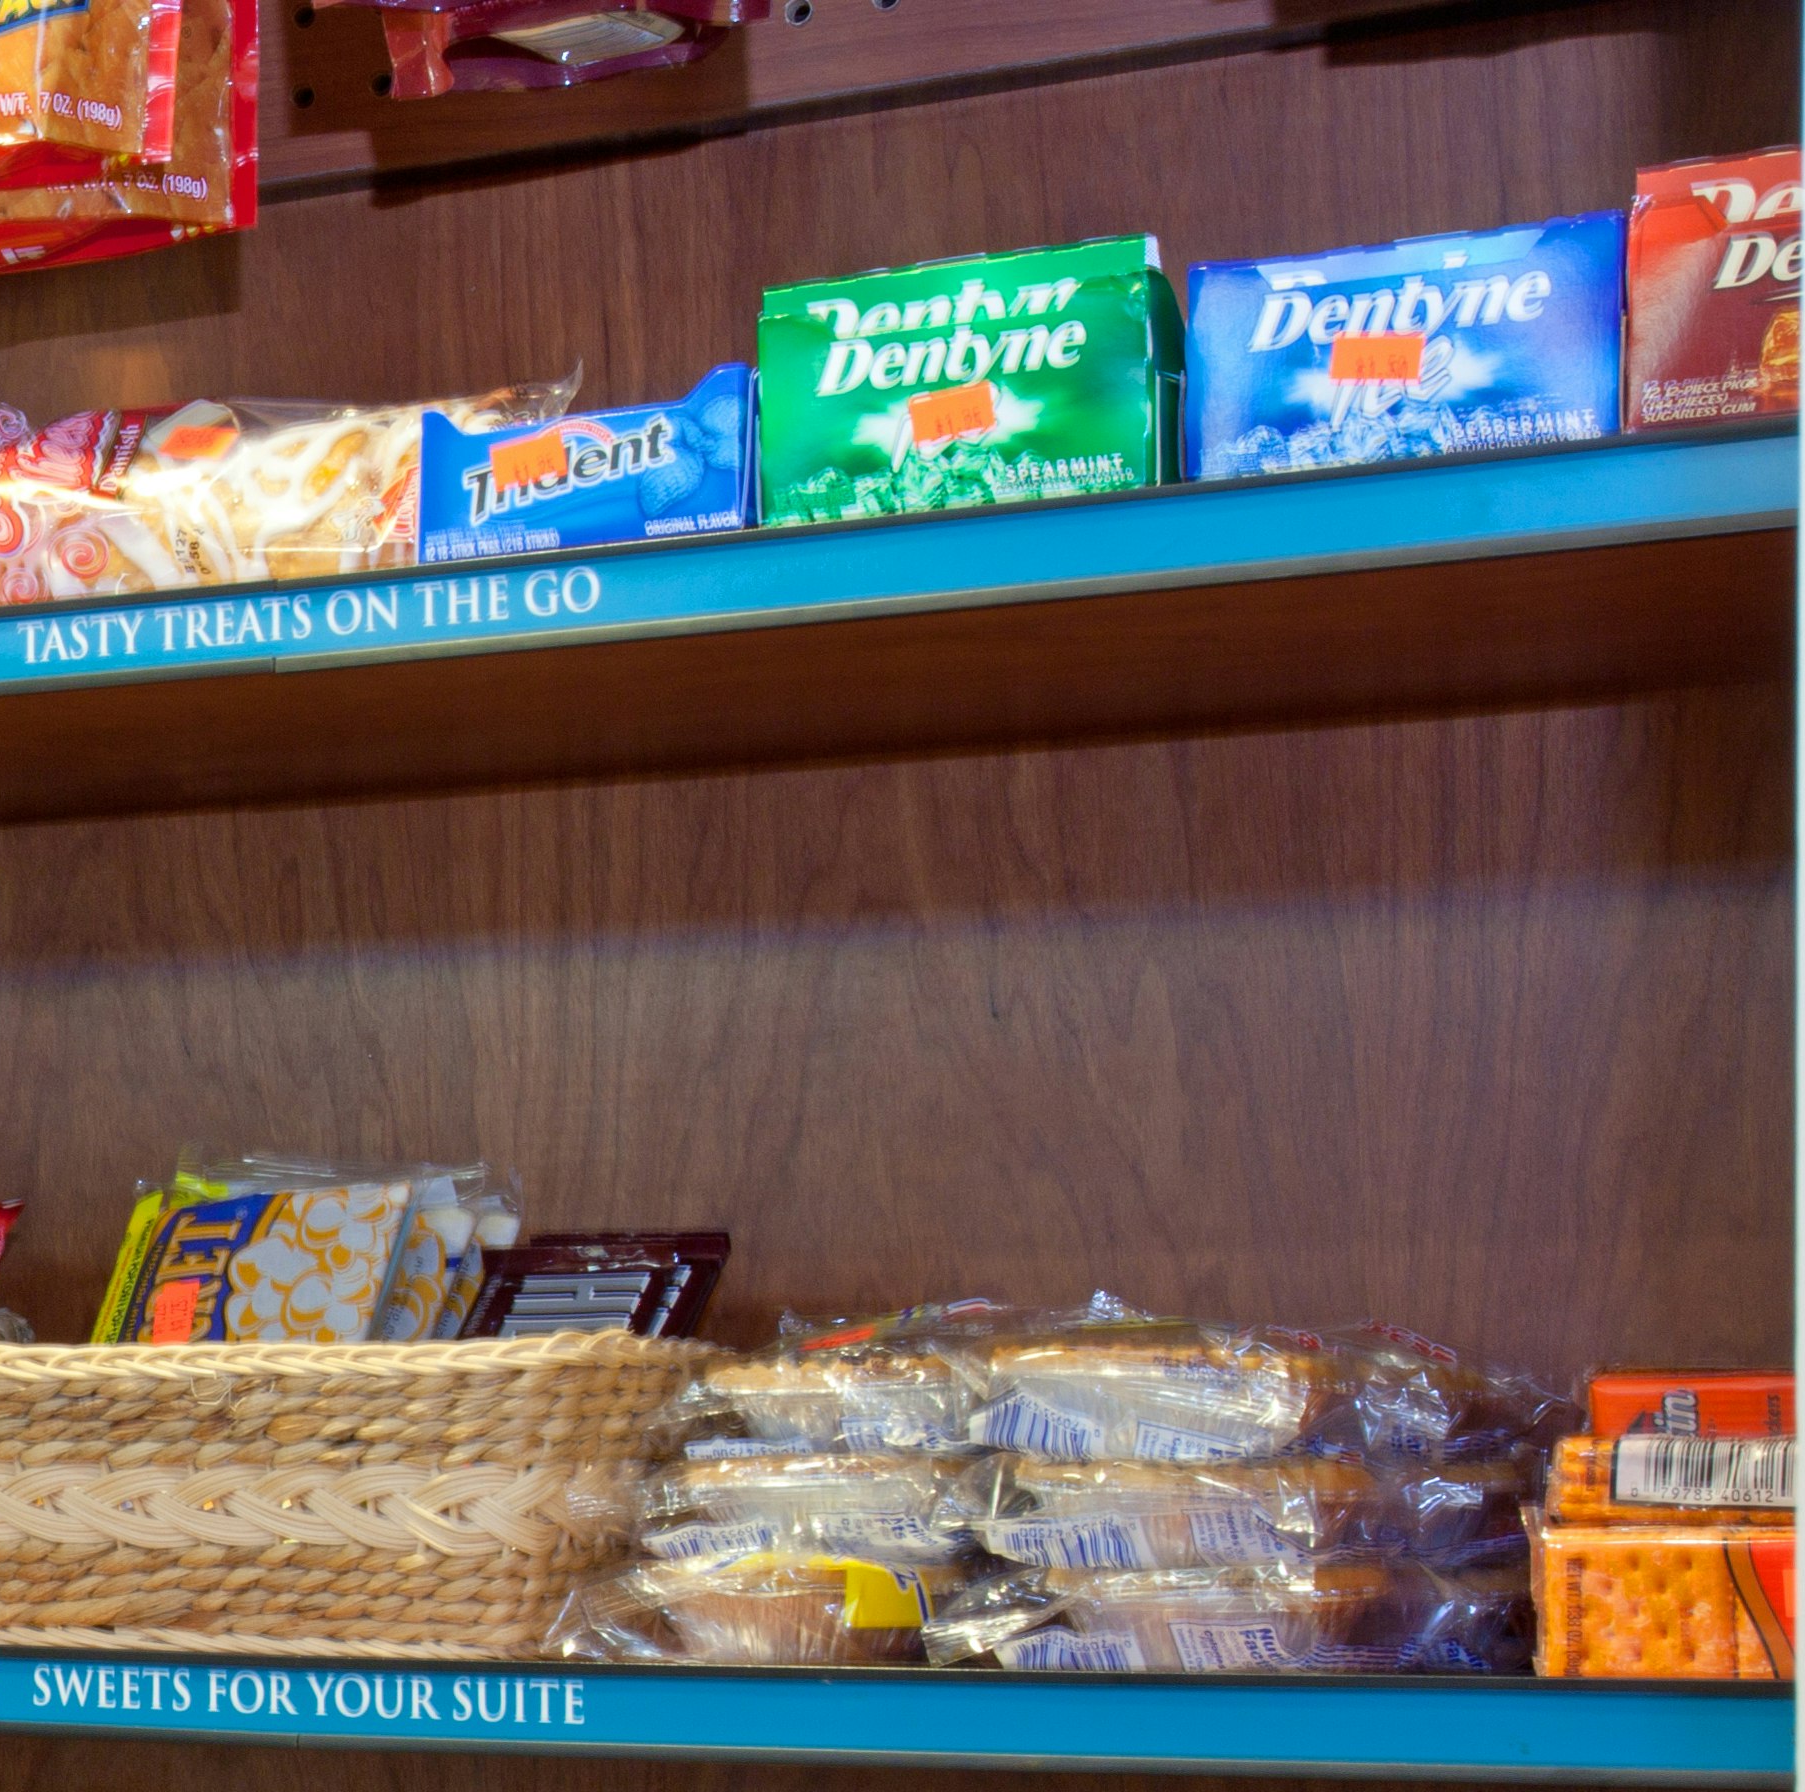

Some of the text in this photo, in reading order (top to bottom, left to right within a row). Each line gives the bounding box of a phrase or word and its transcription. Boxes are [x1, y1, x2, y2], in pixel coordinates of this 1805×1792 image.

[1250, 270, 1552, 352] Dentyne
[815, 318, 1086, 399] Dentyne
[1451, 410, 1597, 442] PEPPERMINT
[1642, 401, 1757, 424] SUGARLESS GUM
[98, 424, 141, 495] Danish
[1005, 453, 1124, 483] SPEARMINT
[645, 511, 739, 536] ORIGINAL FLAVOR
[16, 564, 603, 665] TASTY TREATS ON THE GO
[32, 1660, 587, 1726] SWEETS FOR YOUR SUITE
